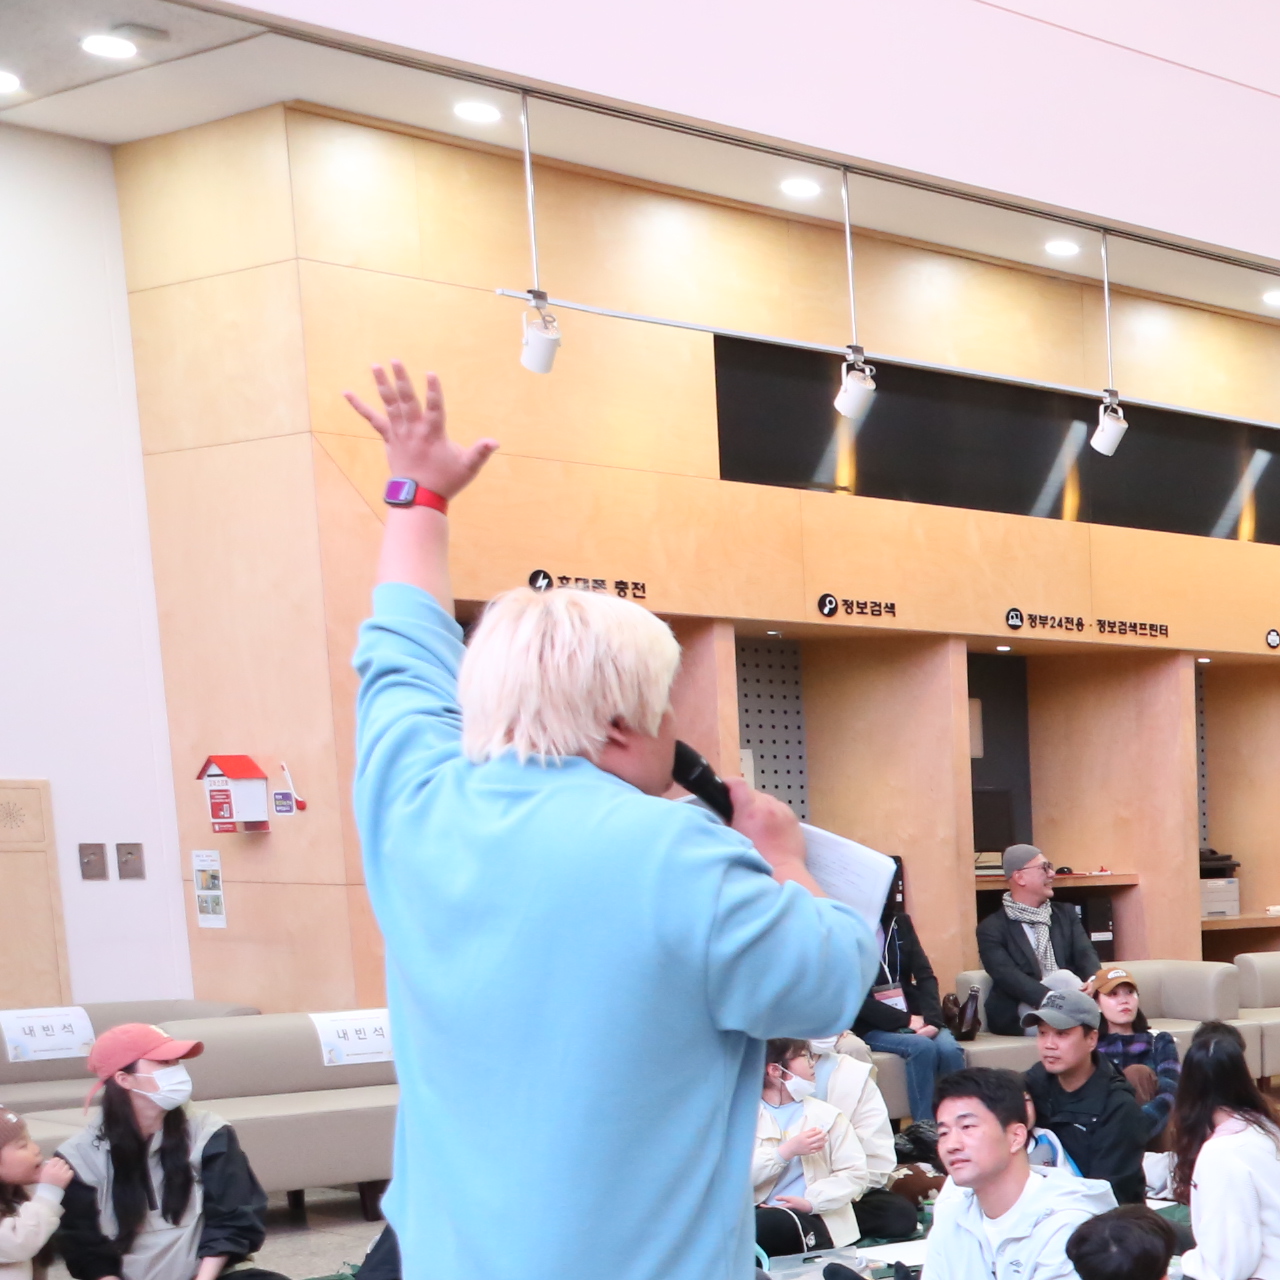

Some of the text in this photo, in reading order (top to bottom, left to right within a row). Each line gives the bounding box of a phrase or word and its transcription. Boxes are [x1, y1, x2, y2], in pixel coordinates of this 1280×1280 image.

[614, 578, 647, 600] 충전
[841, 598, 896, 618] 정보검색
[1027, 613, 1169, 638] 정부24전용 정보검색프린터
